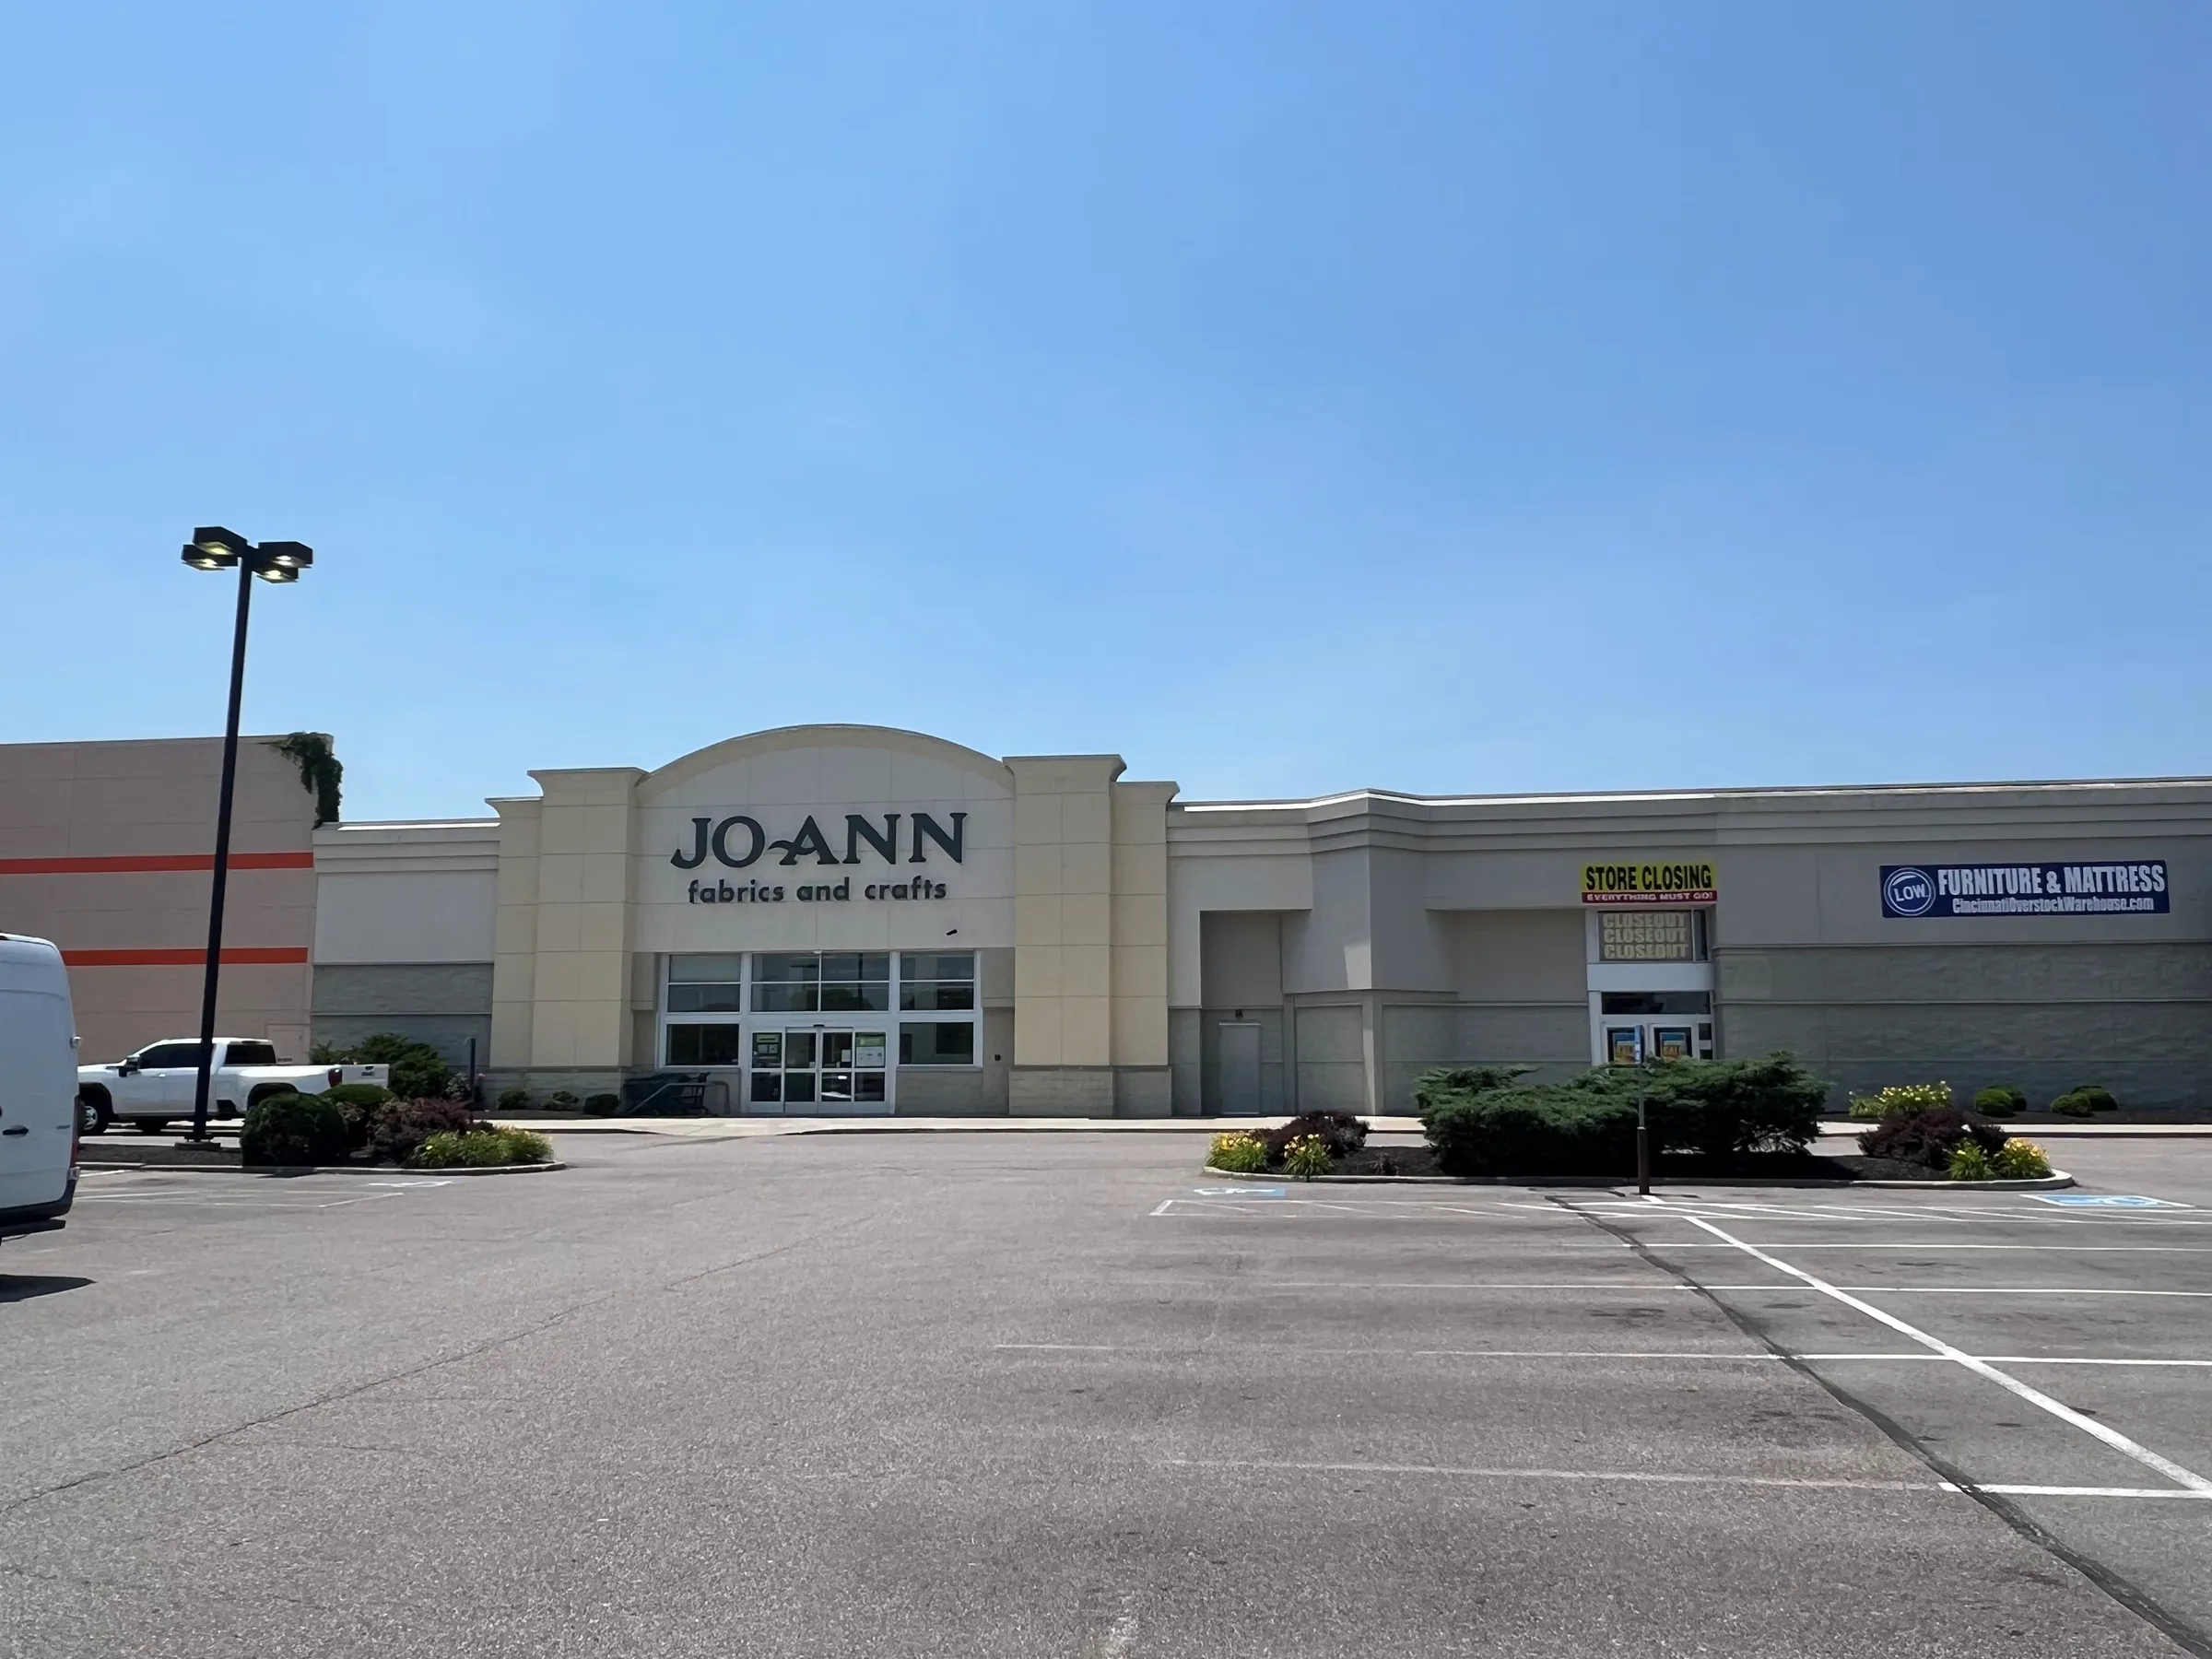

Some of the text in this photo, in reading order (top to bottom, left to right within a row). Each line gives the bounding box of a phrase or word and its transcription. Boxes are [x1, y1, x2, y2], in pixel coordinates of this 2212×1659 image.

[1585, 865, 1712, 891] STORE CLOSING
[1937, 865, 2165, 896] FURNITURE & MATTRESS
[688, 876, 947, 904] fabrics and crafts
[1586, 891, 1713, 901] EVERYTHING MUST GO!
[1893, 883, 1926, 902] LOW
[1952, 897, 2154, 913] CincinnatiOverstockWarehouse.com
[1603, 912, 1687, 928] CLOSEOUT
[1603, 927, 1687, 944] CLOSEOUT
[1604, 943, 1688, 959] CLOSEOUT
